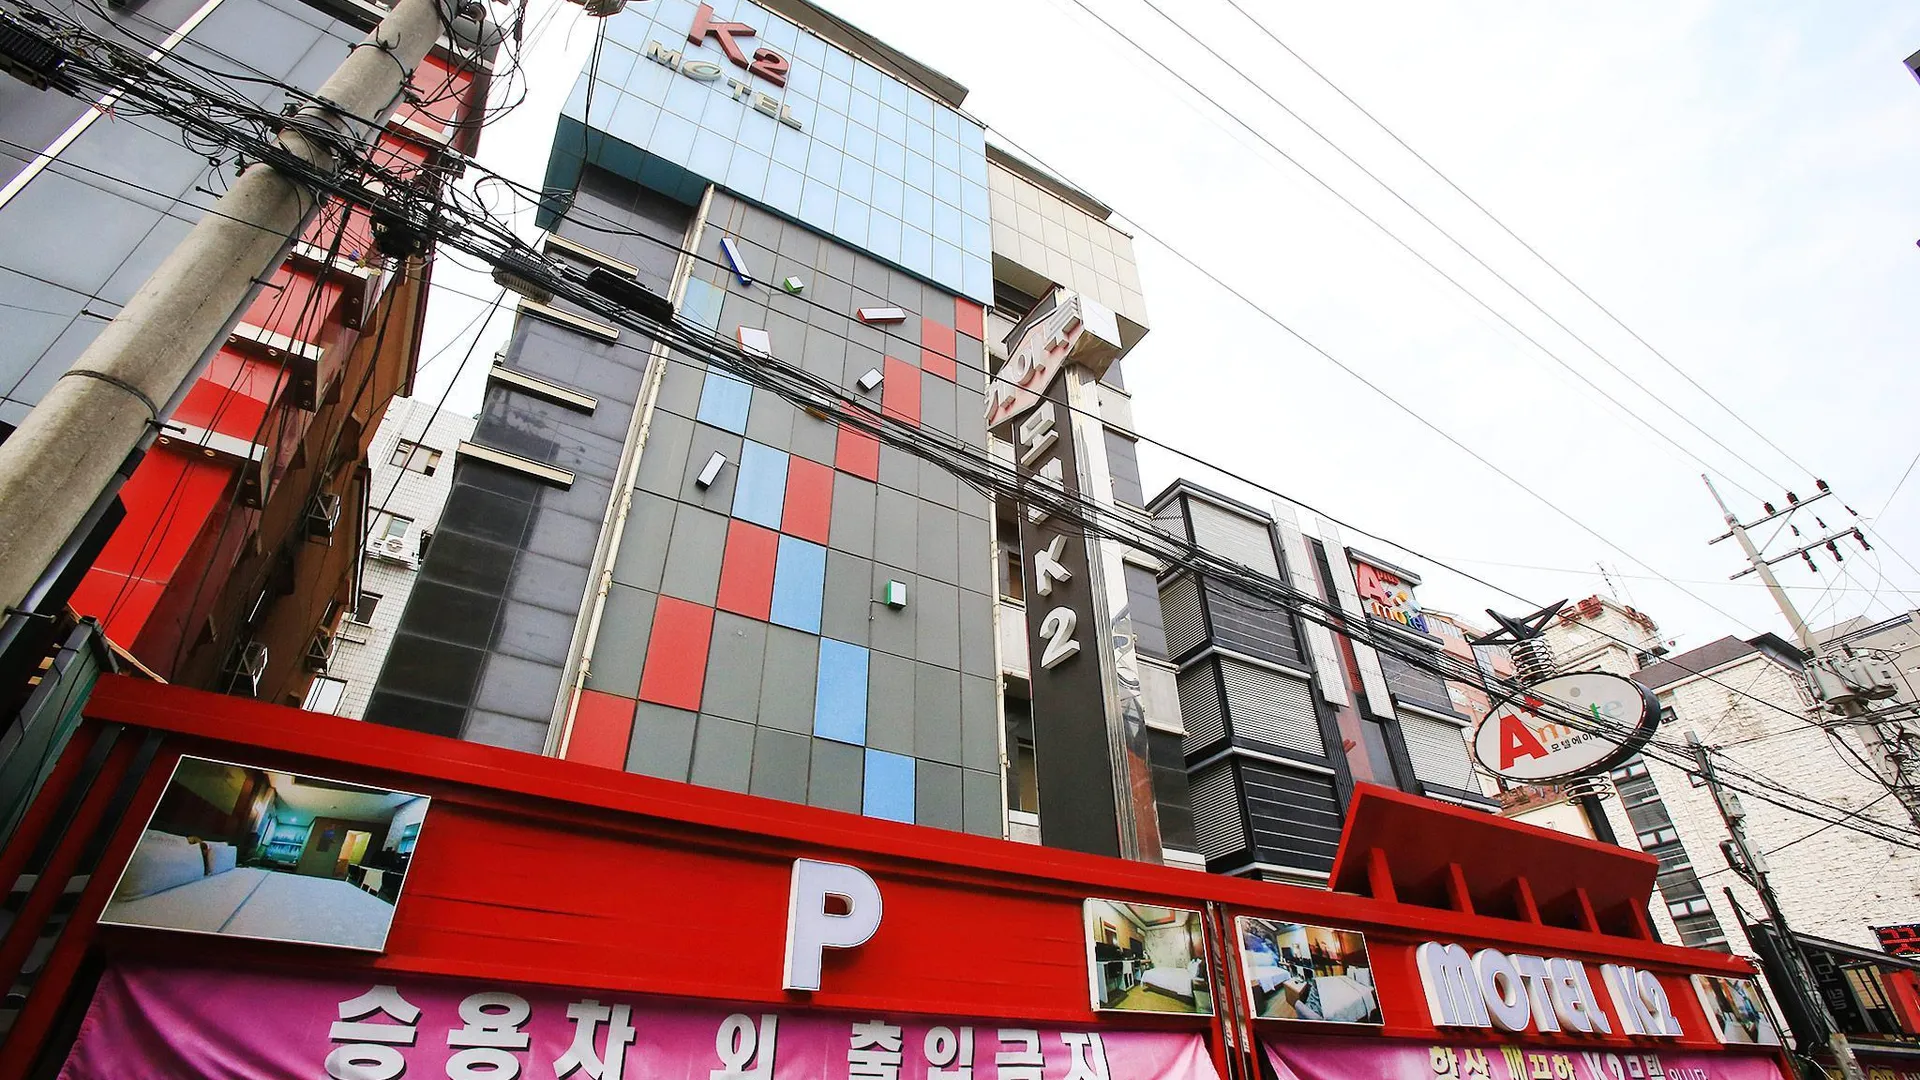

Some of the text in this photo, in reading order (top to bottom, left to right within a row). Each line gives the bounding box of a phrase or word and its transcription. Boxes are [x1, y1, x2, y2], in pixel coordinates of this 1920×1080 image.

[647, 40, 803, 130] MOTEL
[688, 2, 790, 88] K2
[1034, 533, 1082, 670] K2
[1371, 601, 1429, 634] motel
[782, 857, 884, 992] P
[324, 984, 1112, 1080] 승용차 외 출입금지
[1415, 940, 1685, 1037] MOTEL K2
